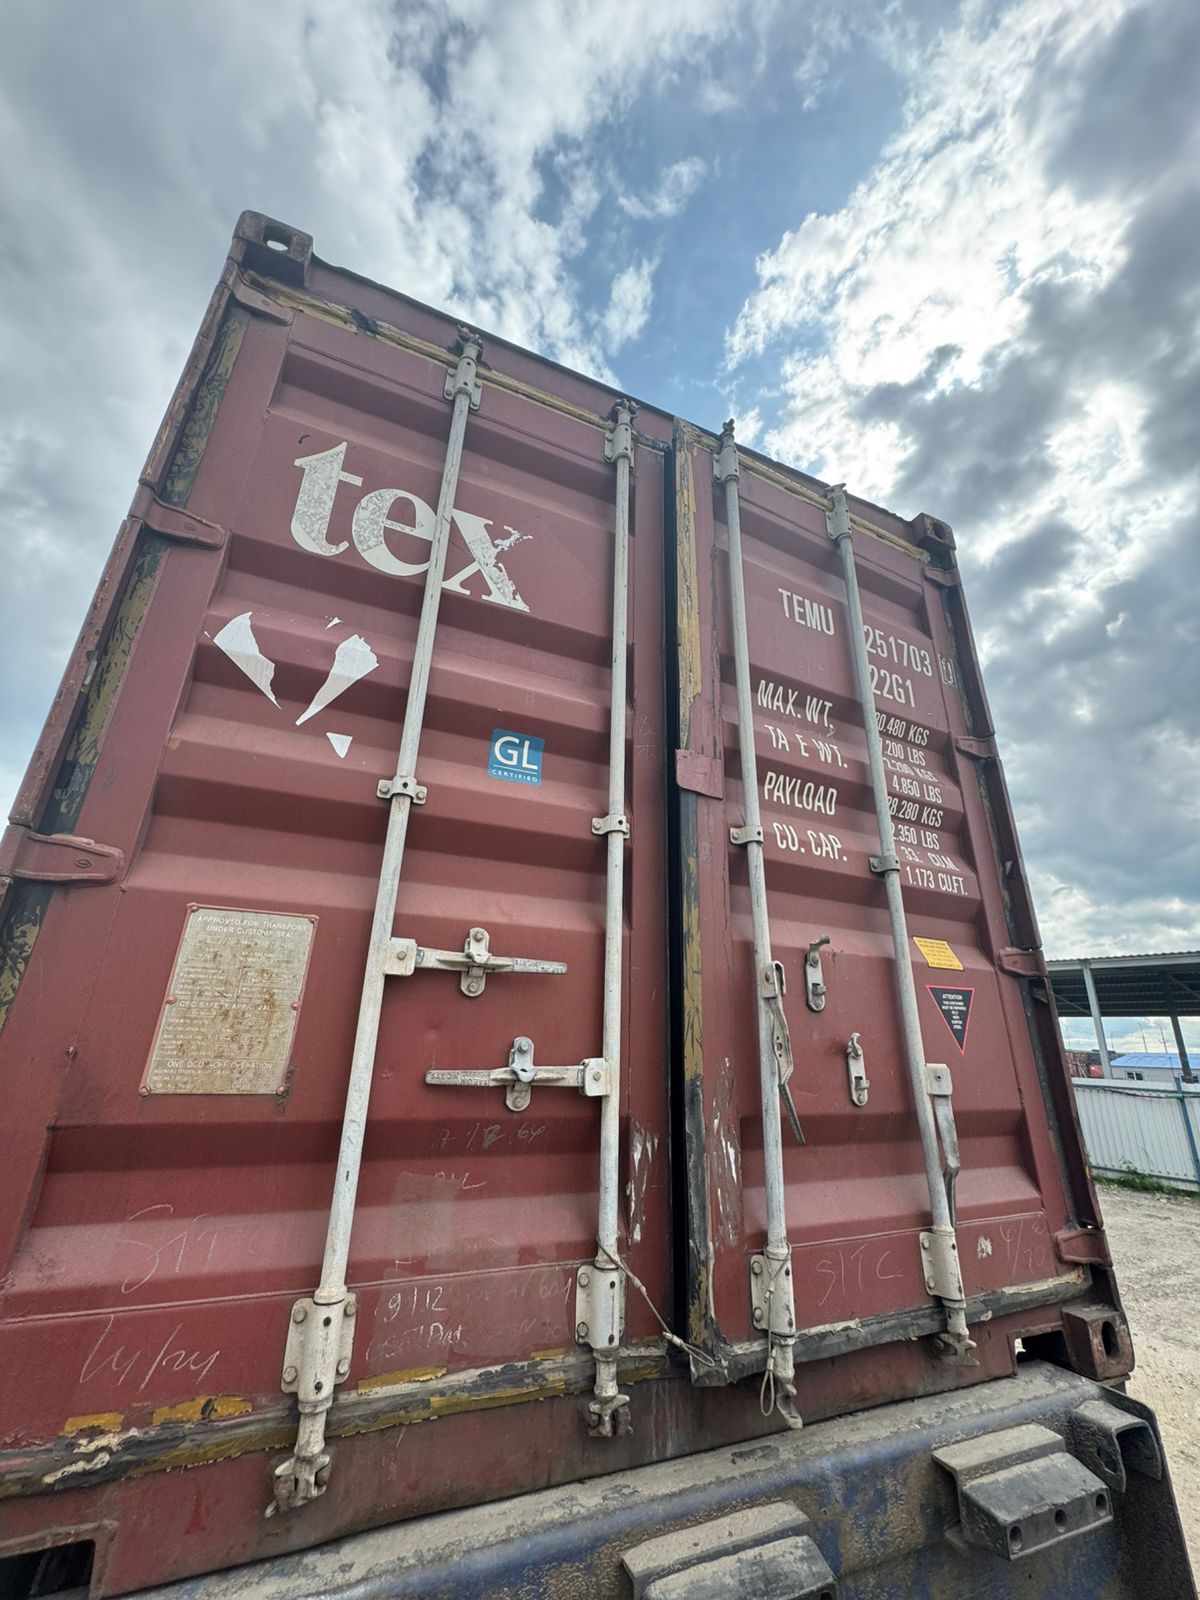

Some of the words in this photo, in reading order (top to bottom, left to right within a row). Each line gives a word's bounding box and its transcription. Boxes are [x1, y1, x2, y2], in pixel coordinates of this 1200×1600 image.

[291, 441, 533, 613] tex
[778, 588, 835, 636] TEMU
[862, 625, 932, 677] 251703
[868, 664, 915, 708] 22G1
[758, 680, 801, 719] MAX.
[805, 695, 834, 729] WT.
[908, 724, 930, 746] KGS
[494, 736, 538, 770] GL
[764, 723, 809, 757] TAE
[907, 746, 926, 766] LBS
[491, 769, 538, 783] CERTIFIED
[764, 771, 837, 815] PAYLOAD
[892, 774, 920, 798] 4.850
[923, 783, 943, 804] LBS
[921, 806, 943, 828] KGS
[773, 822, 805, 853] CU.
[807, 830, 848, 862] CAP.
[920, 829, 940, 850] LBS
[906, 866, 935, 889] 1.173
[206, 925, 234, 934] UNDER
